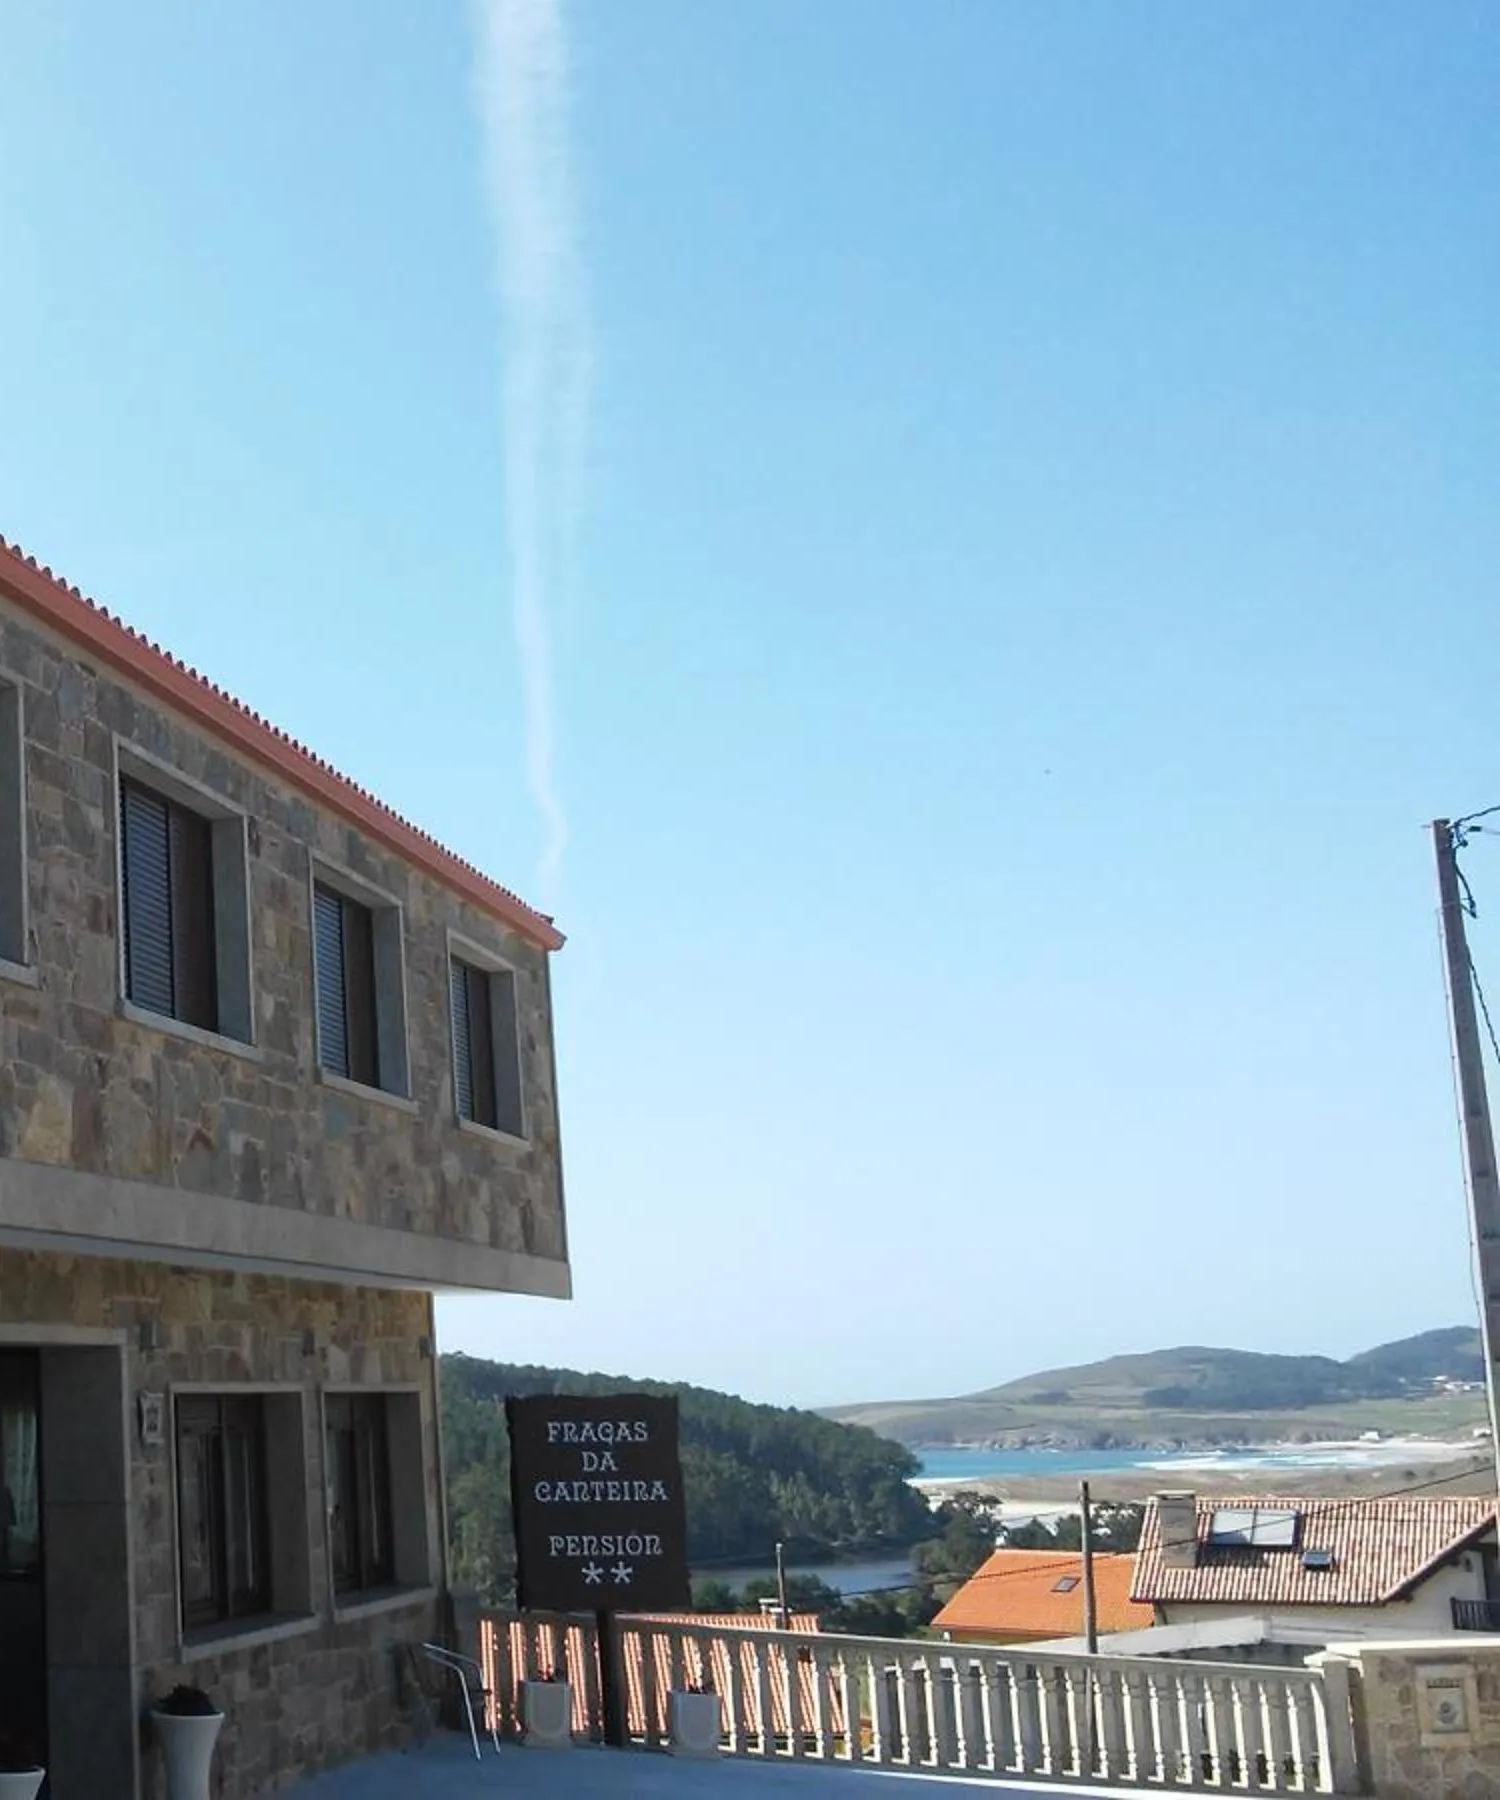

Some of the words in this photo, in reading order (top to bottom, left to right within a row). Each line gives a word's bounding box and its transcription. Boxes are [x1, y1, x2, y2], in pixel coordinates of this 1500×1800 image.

[547, 1421, 648, 1445] FRAGAS
[581, 1451, 619, 1472] DA
[534, 1480, 668, 1502] CANTEIRA
